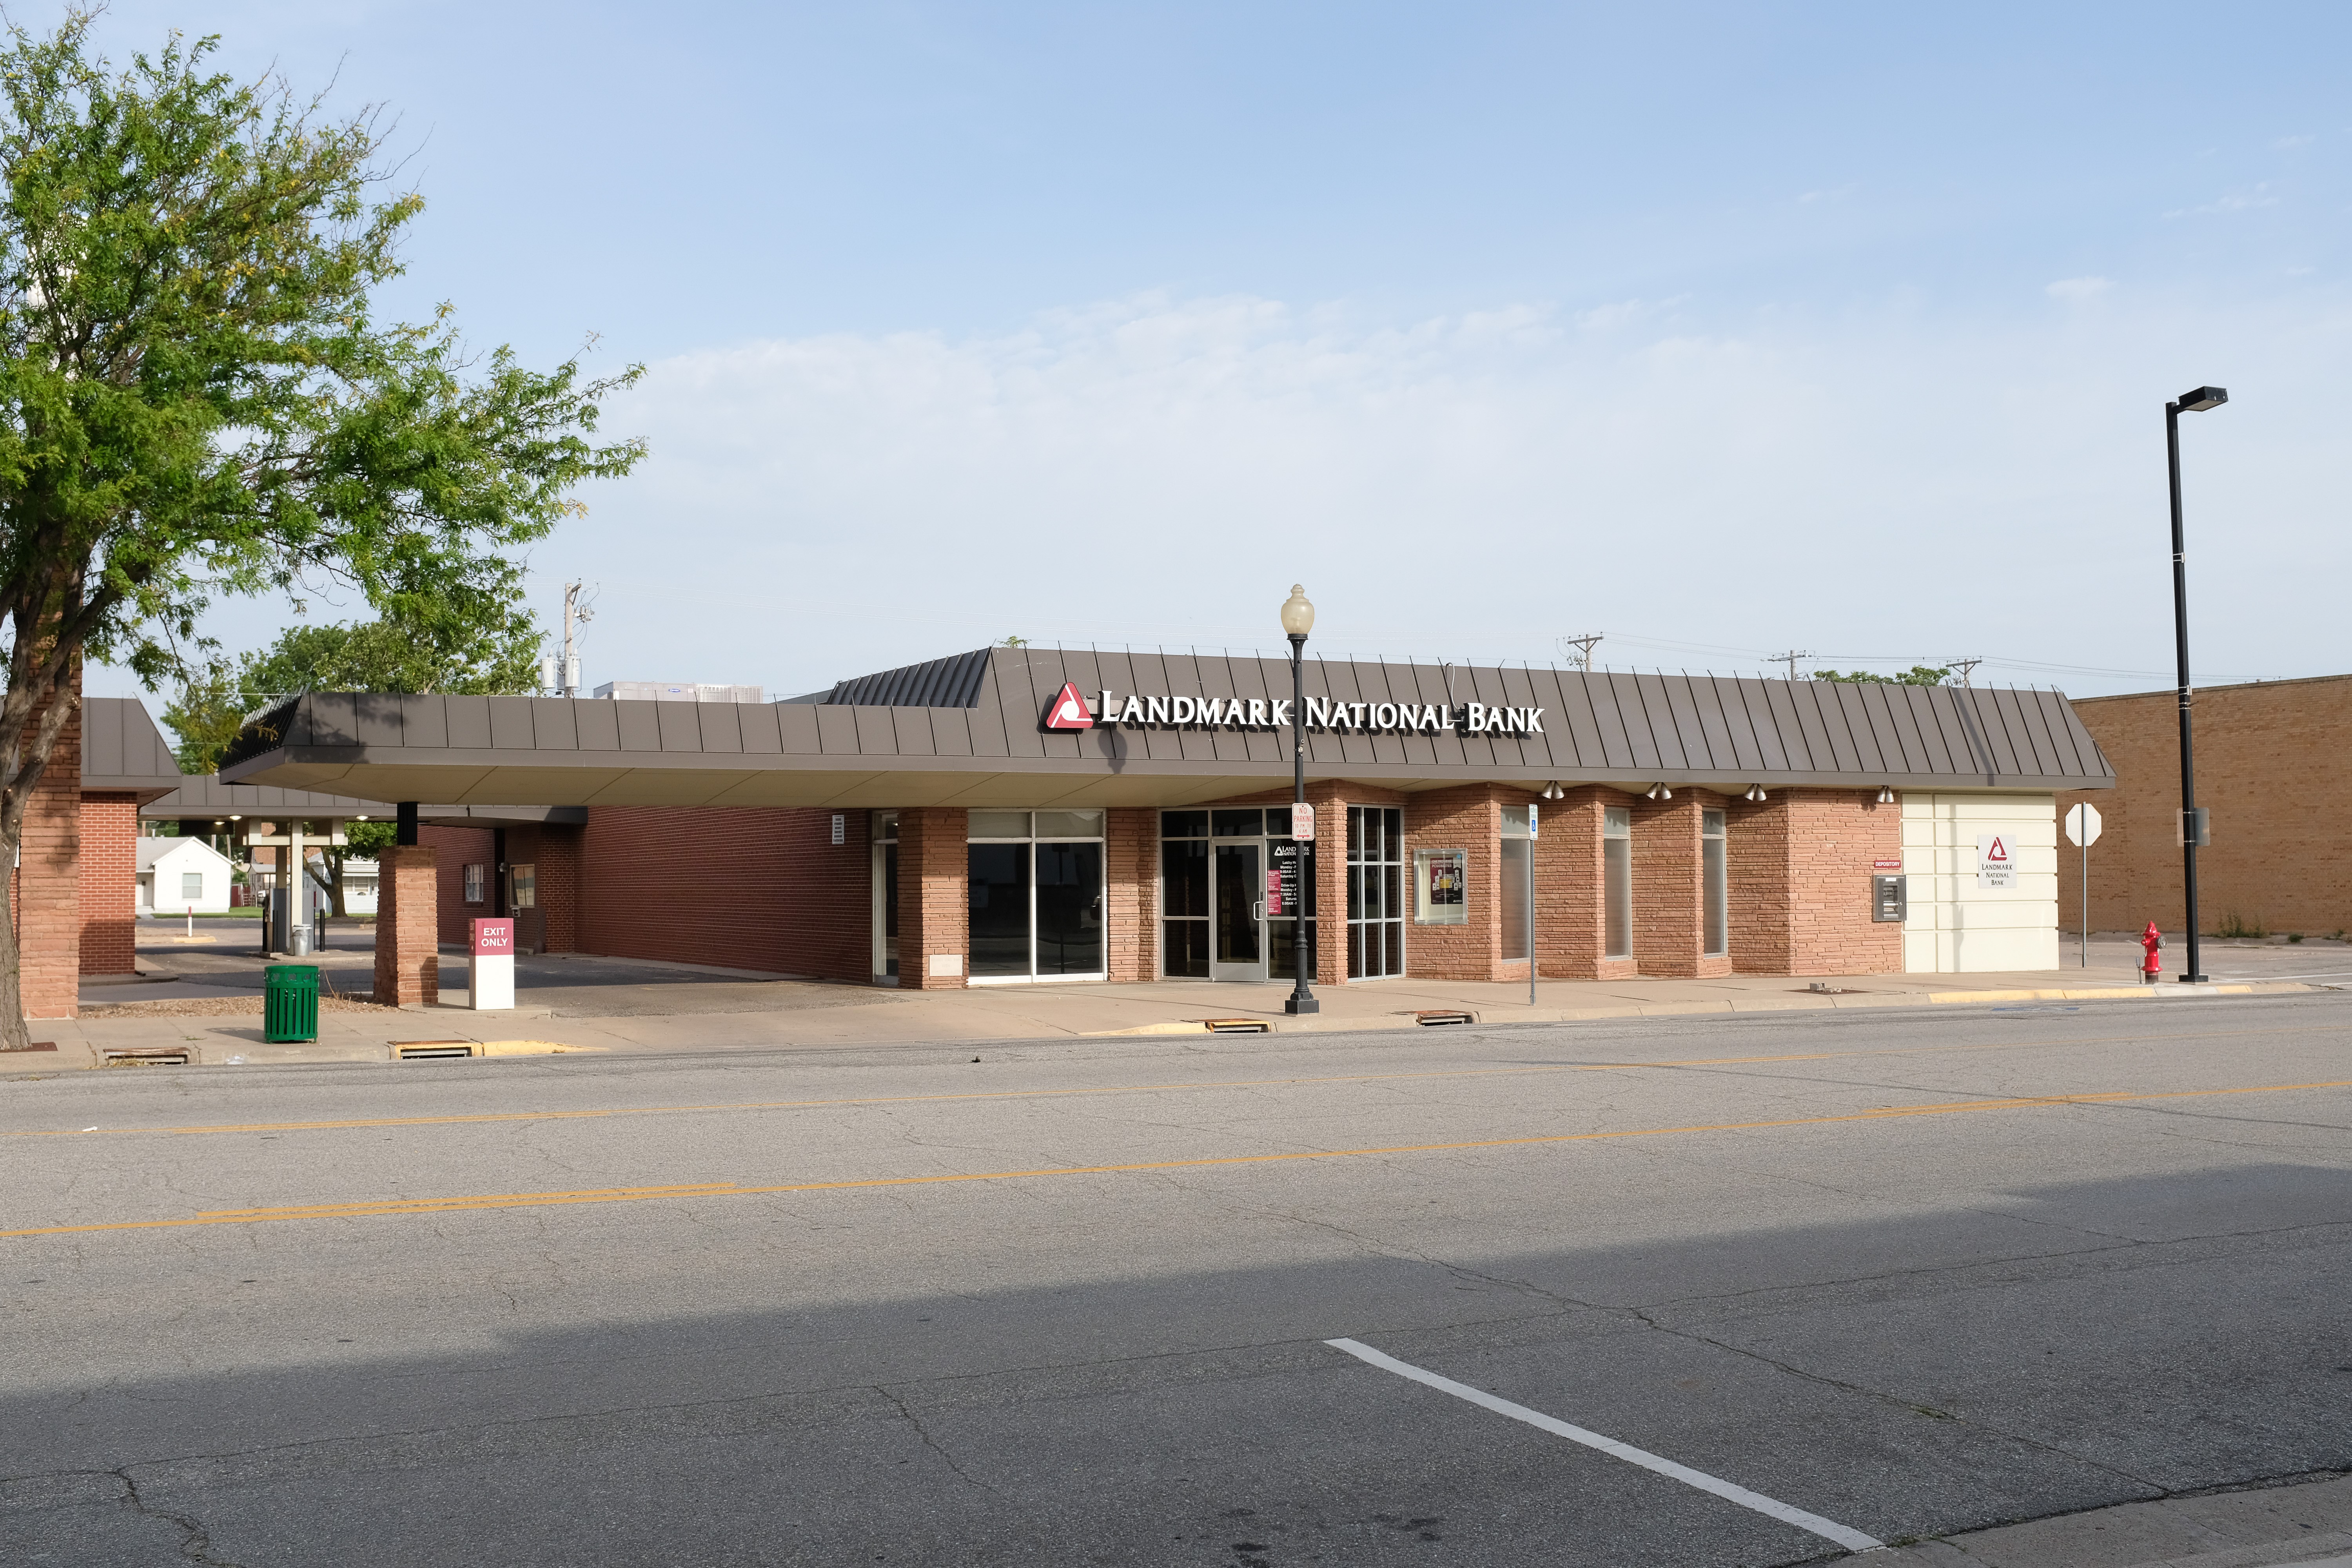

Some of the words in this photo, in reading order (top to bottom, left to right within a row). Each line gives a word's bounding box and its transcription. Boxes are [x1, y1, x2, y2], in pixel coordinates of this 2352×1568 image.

[1100, 690, 1292, 726] LANDMARK
[1304, 696, 1455, 730] NATIONAL
[1466, 702, 1545, 733] BANK
[483, 927, 506, 936] EXIT
[481, 938, 508, 947] ONLY
